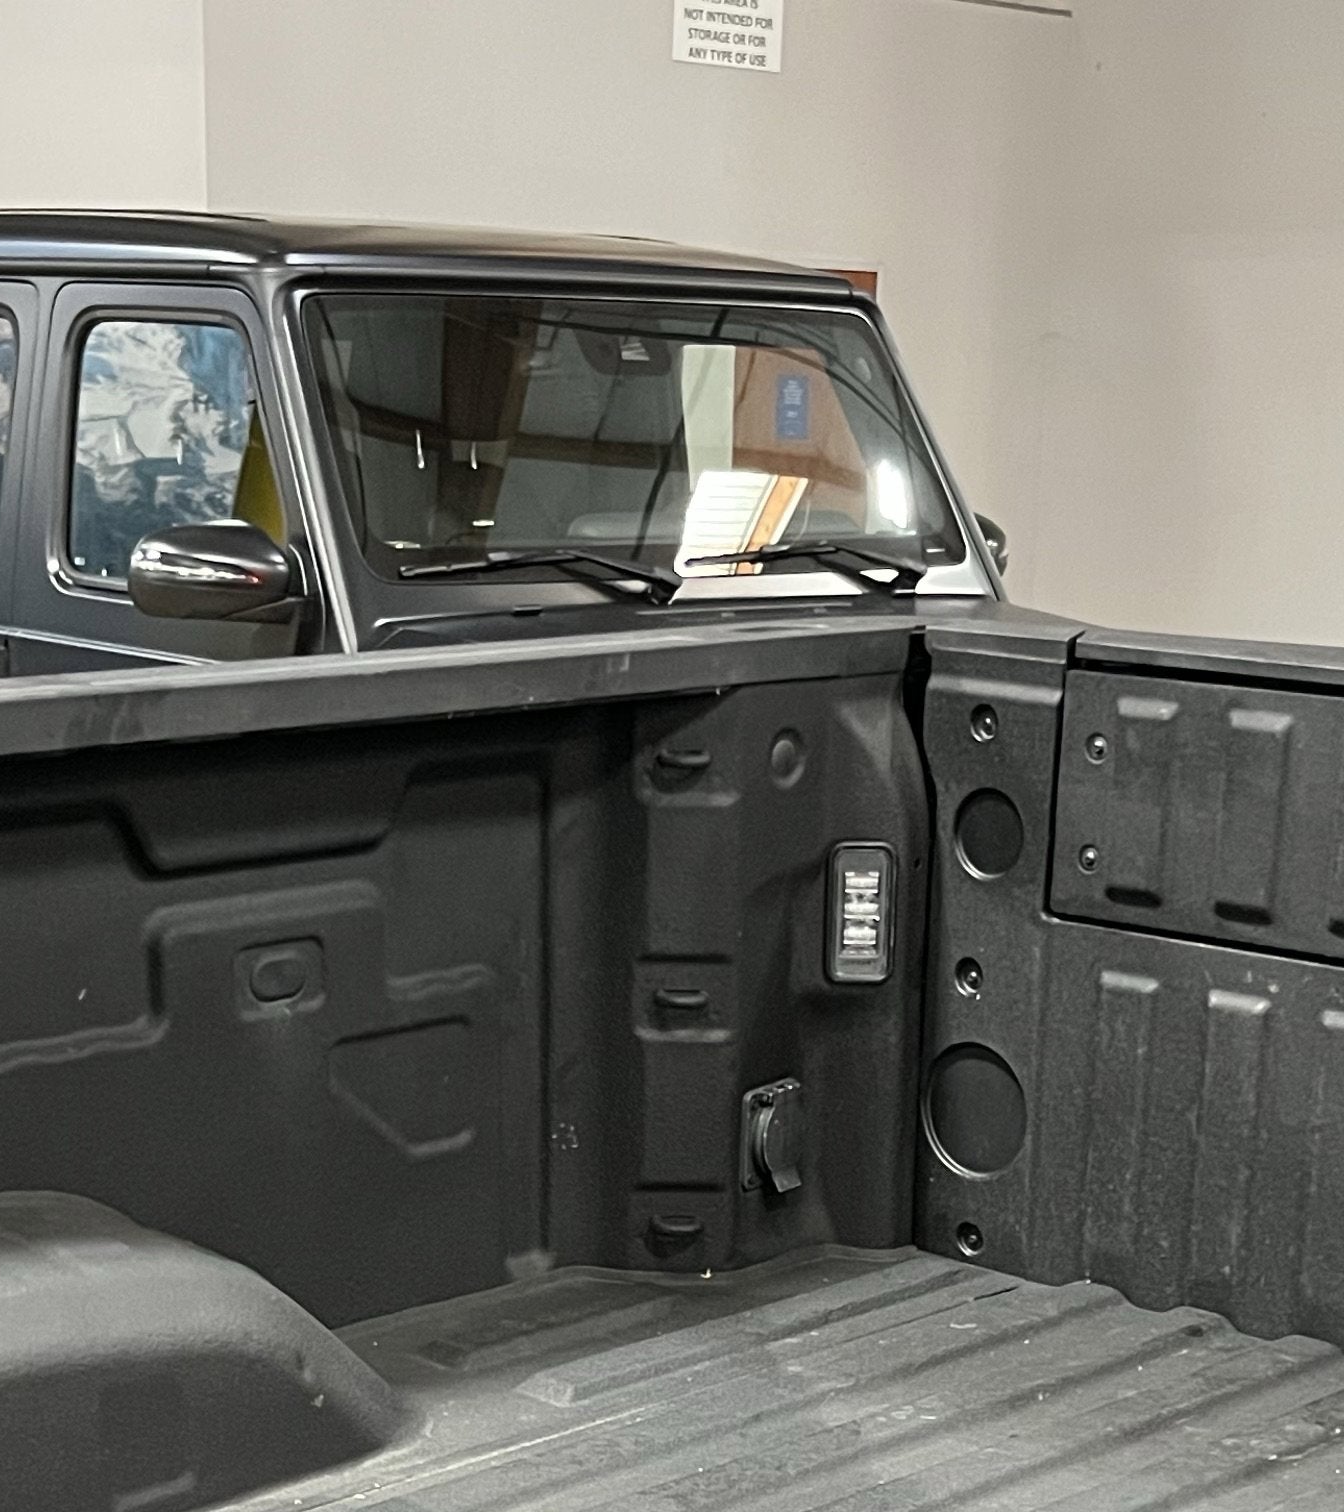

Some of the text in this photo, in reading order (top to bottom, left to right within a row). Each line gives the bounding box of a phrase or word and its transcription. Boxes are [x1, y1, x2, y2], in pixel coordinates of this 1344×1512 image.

[684, 8, 773, 30] NOT INTENDED FOR
[688, 28, 766, 48] STORAGE OR FOR
[688, 47, 766, 67] ANY TYPE OF USE
